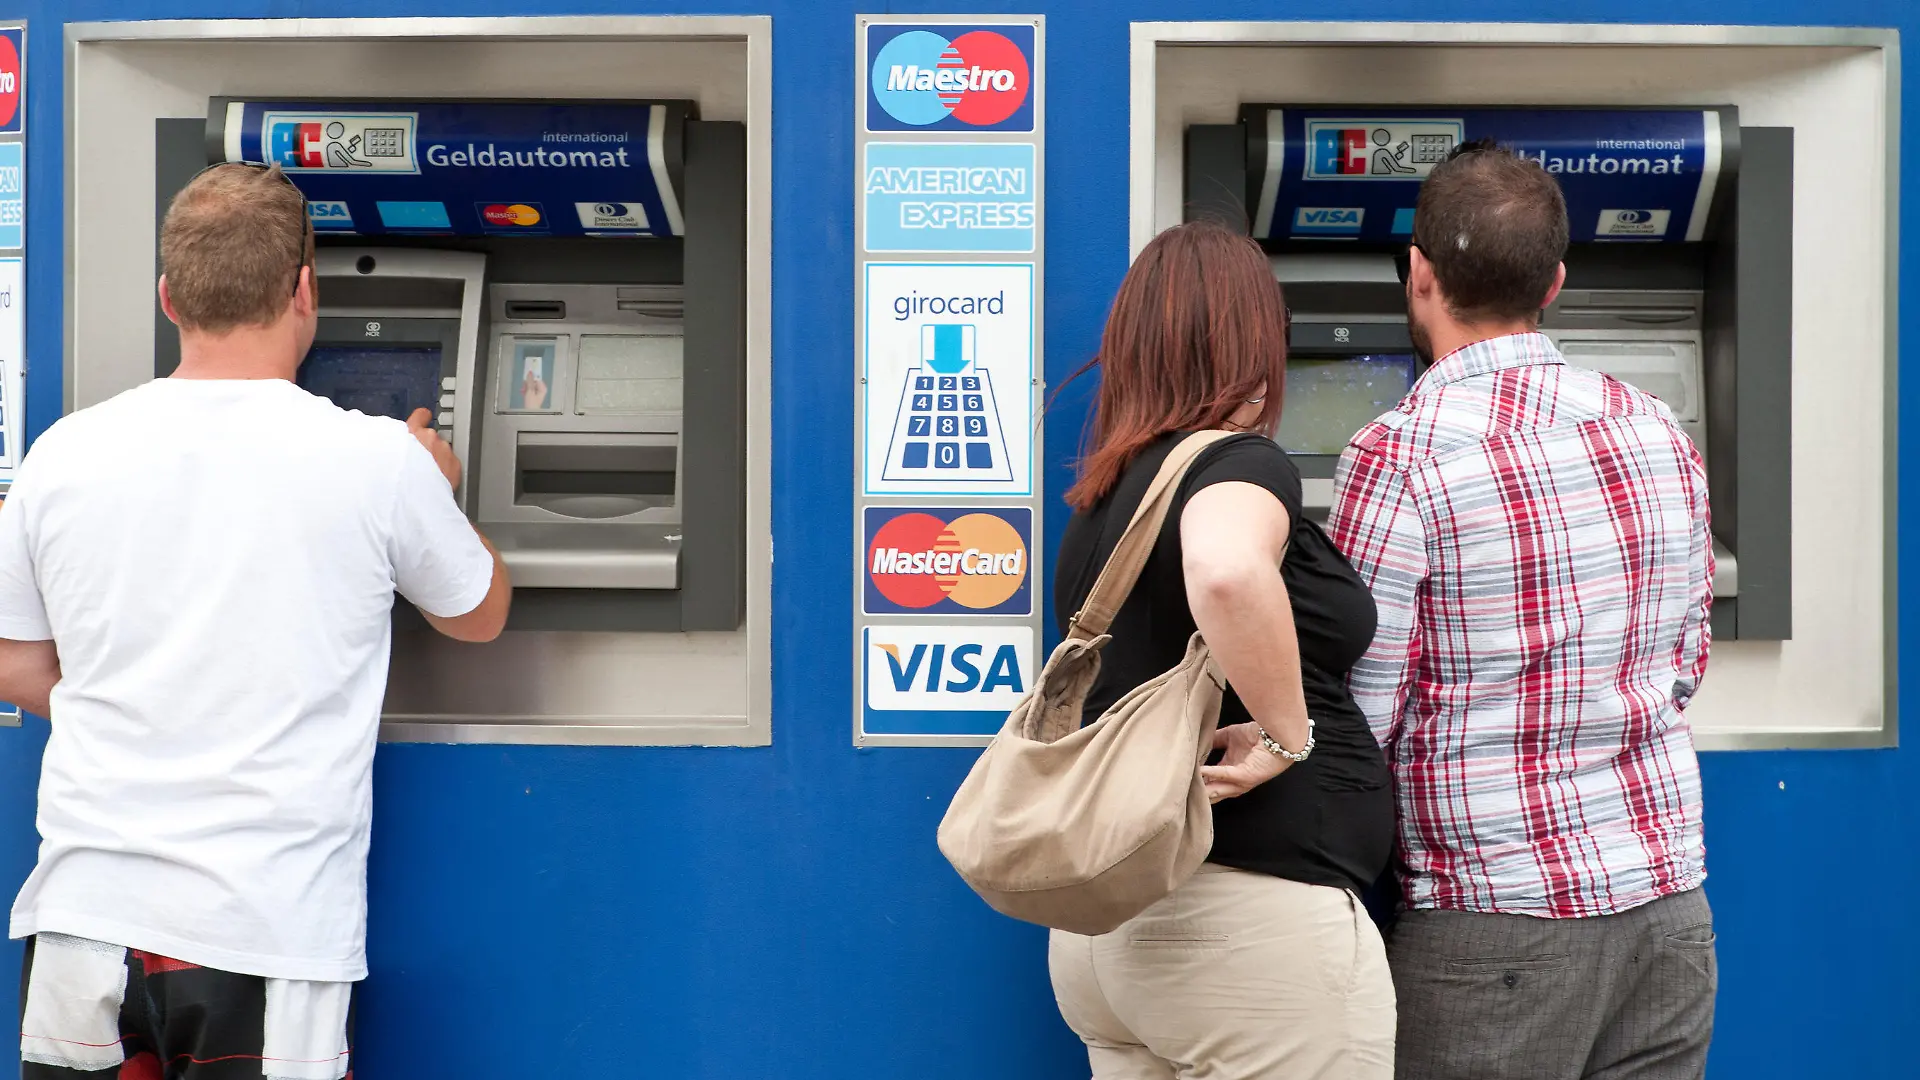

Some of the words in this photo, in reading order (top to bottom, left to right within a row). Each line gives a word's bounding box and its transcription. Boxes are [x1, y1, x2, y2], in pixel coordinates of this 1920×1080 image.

[887, 65, 1015, 92] Maestro
[543, 132, 628, 143] international
[1596, 139, 1685, 150] international
[427, 143, 630, 168] Geldautomat
[867, 167, 1025, 194] AMERICAN
[307, 203, 346, 217] ISA
[486, 211, 537, 220] Master
[900, 202, 1035, 229] EXPRESS
[1304, 210, 1359, 223] VISA
[894, 290, 1004, 321] girocard
[922, 378, 928, 389] 1
[944, 378, 952, 389] 2
[967, 378, 976, 389] 3
[917, 396, 928, 409] 4
[943, 396, 953, 409] 5
[968, 396, 978, 409] 6
[914, 418, 926, 433] 7
[942, 418, 954, 433] 8
[970, 418, 981, 433] 9
[941, 446, 954, 464] 0
[872, 548, 1022, 575] MasterCard
[872, 643, 1024, 693] VISA
